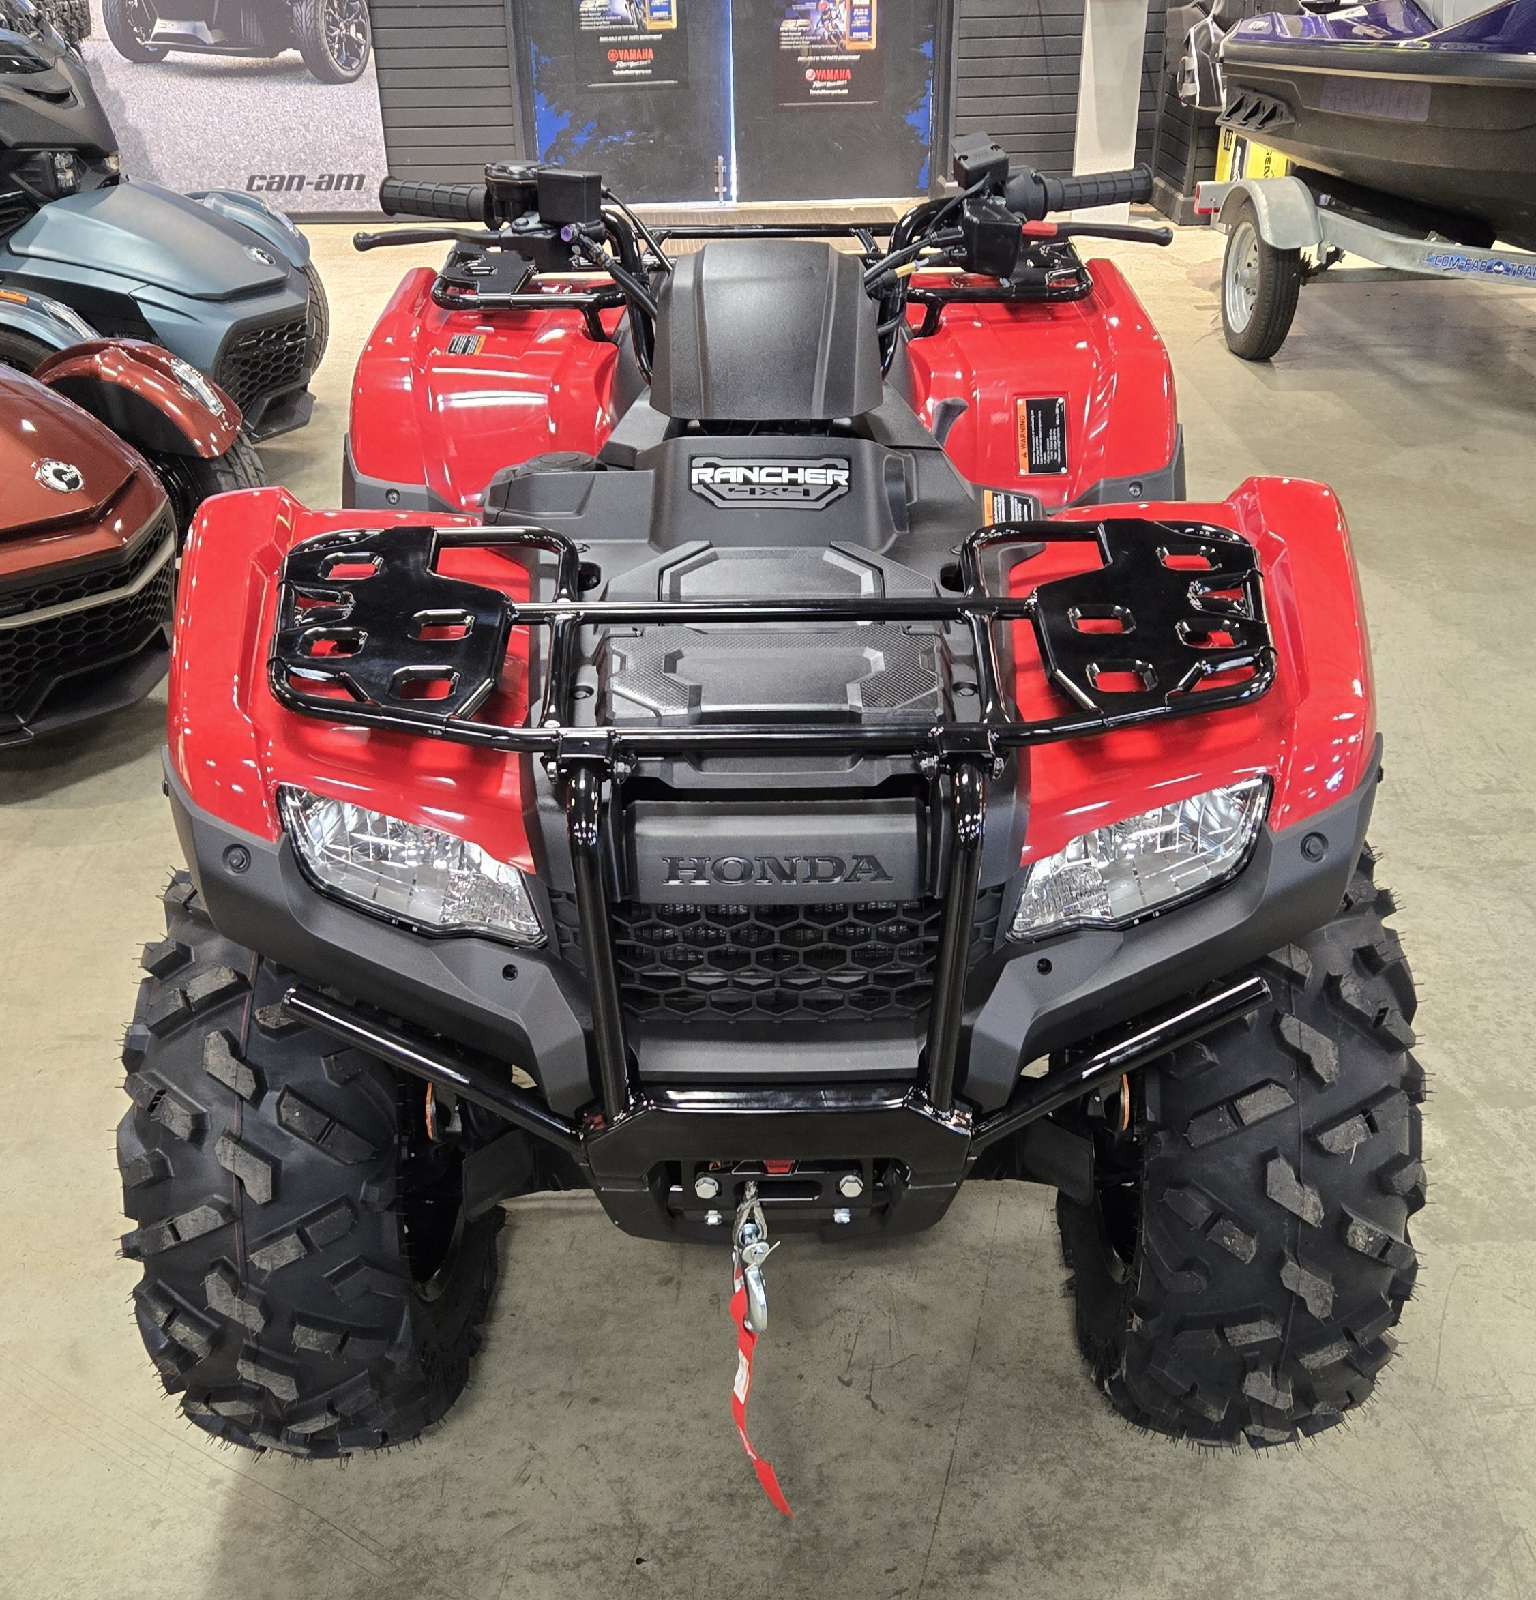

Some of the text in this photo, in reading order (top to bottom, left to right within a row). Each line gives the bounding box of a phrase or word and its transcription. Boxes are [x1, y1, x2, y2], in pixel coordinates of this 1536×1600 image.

[618, 48, 654, 60] YAMAHA
[815, 69, 851, 80] YAMAHA
[246, 174, 366, 192] can-am
[691, 466, 849, 487] RANCHER
[662, 855, 895, 886] HONDA
